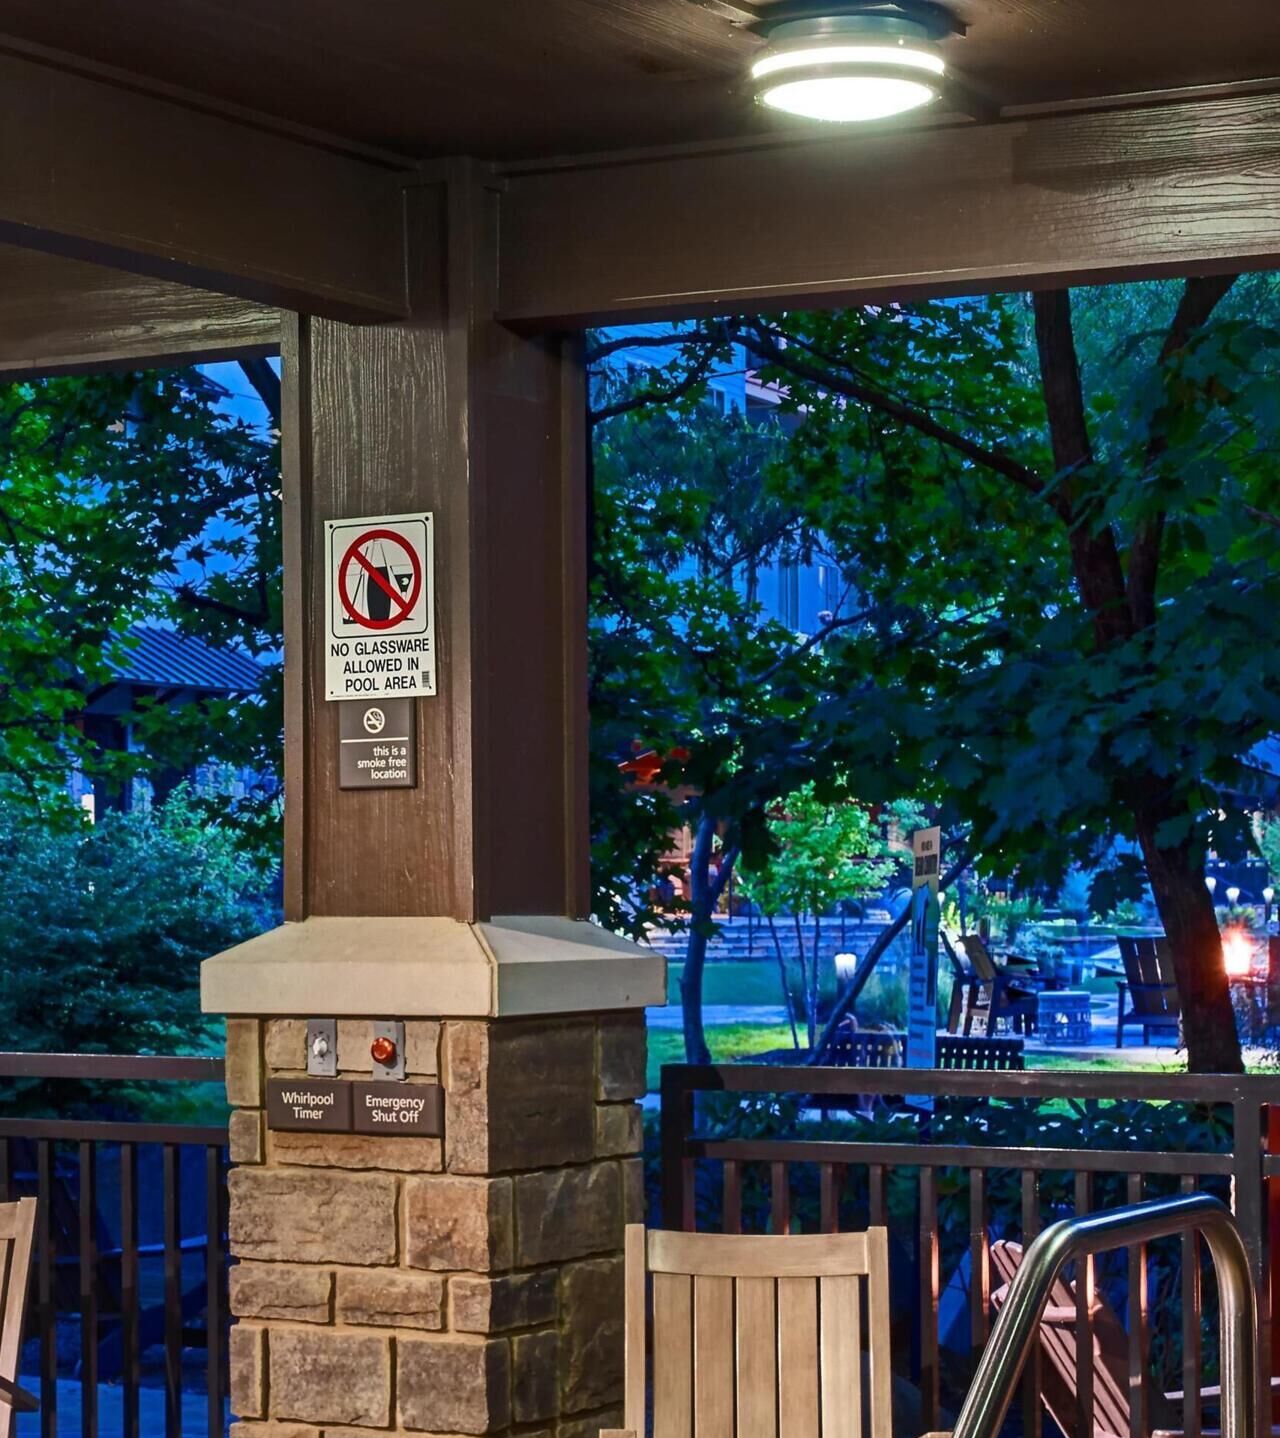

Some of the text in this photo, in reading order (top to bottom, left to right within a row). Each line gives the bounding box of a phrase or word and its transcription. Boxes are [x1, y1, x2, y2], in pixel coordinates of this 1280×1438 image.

[331, 638, 430, 656] NO GLASSWARE
[343, 657, 419, 674] ALLOWED IN
[346, 676, 417, 692] POOL AREA
[373, 745, 407, 756] this is a
[357, 756, 407, 768] smoke free
[371, 768, 407, 779] location
[281, 1092, 334, 1107] Whirlpool
[365, 1094, 425, 1111] Emergency
[292, 1106, 324, 1119] Timer
[372, 1109, 419, 1123] Shut Off
